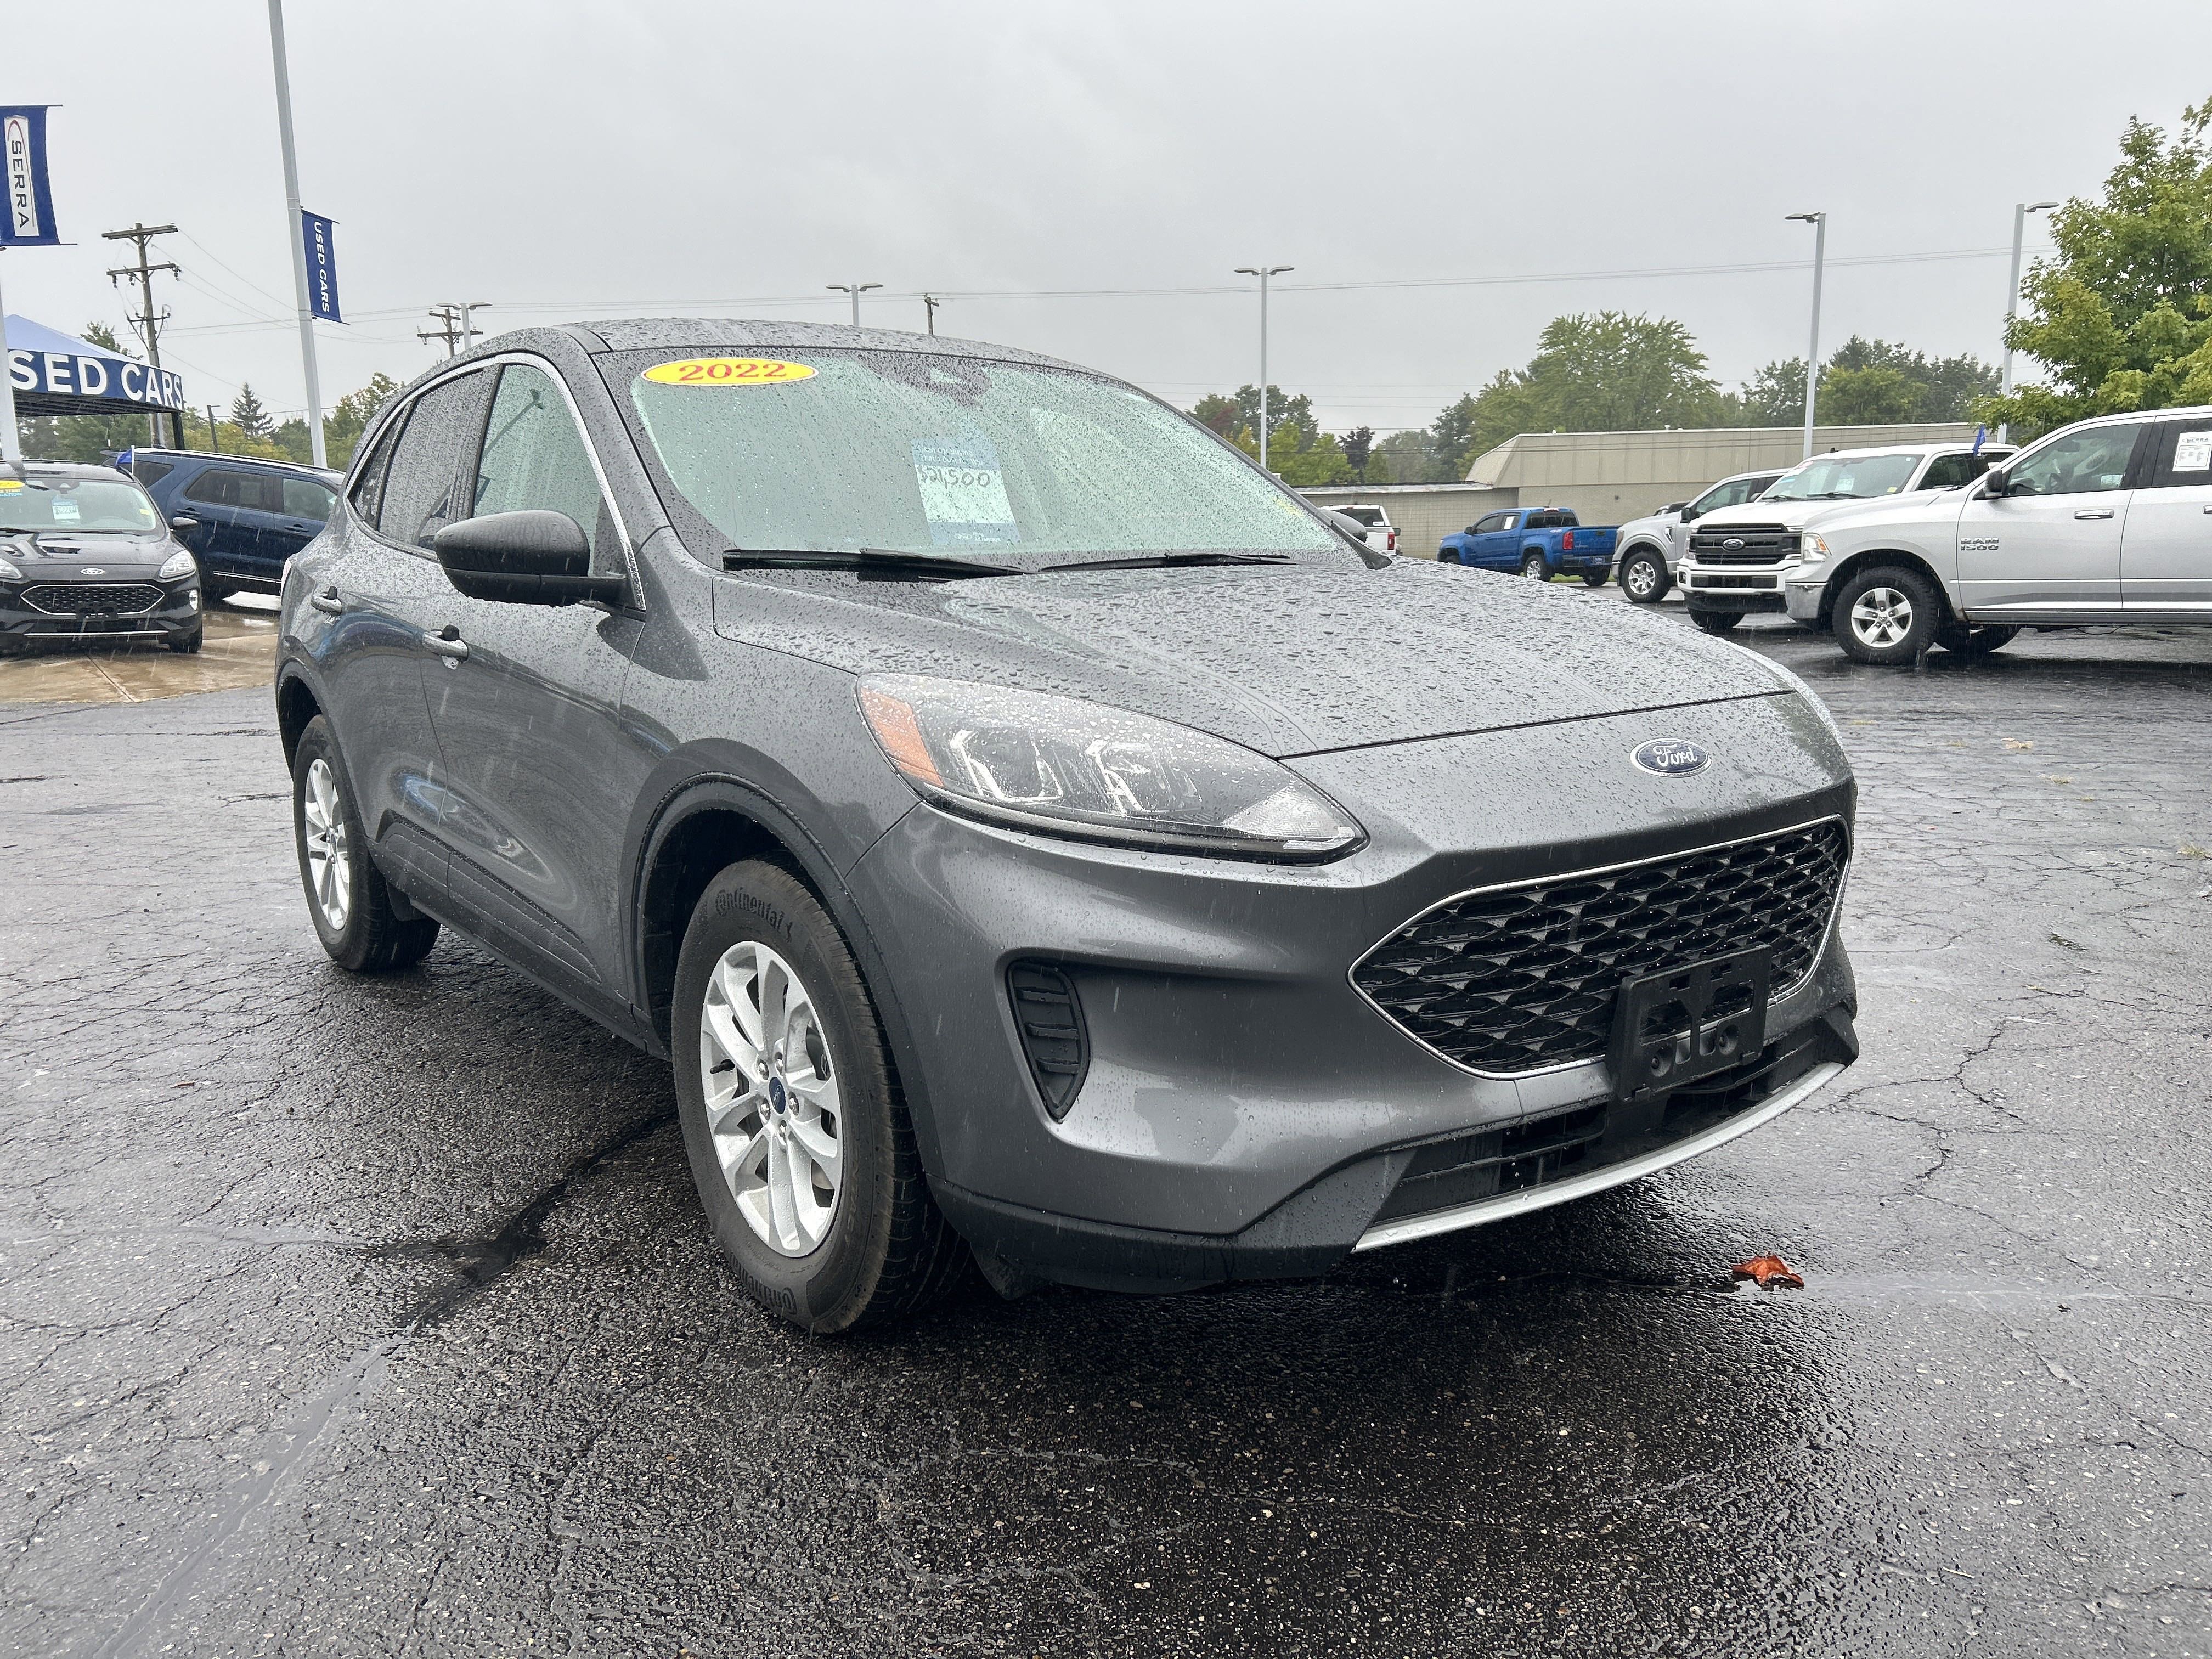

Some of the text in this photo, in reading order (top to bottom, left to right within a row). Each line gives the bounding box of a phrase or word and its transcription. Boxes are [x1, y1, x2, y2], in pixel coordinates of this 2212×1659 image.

[12, 140, 29, 228] SERRA
[314, 221, 330, 313] USED CARS
[8, 350, 184, 410] SED CARS
[679, 363, 787, 381] 2022
[1652, 744, 1697, 767] Ford
[715, 886, 785, 932] Continental
